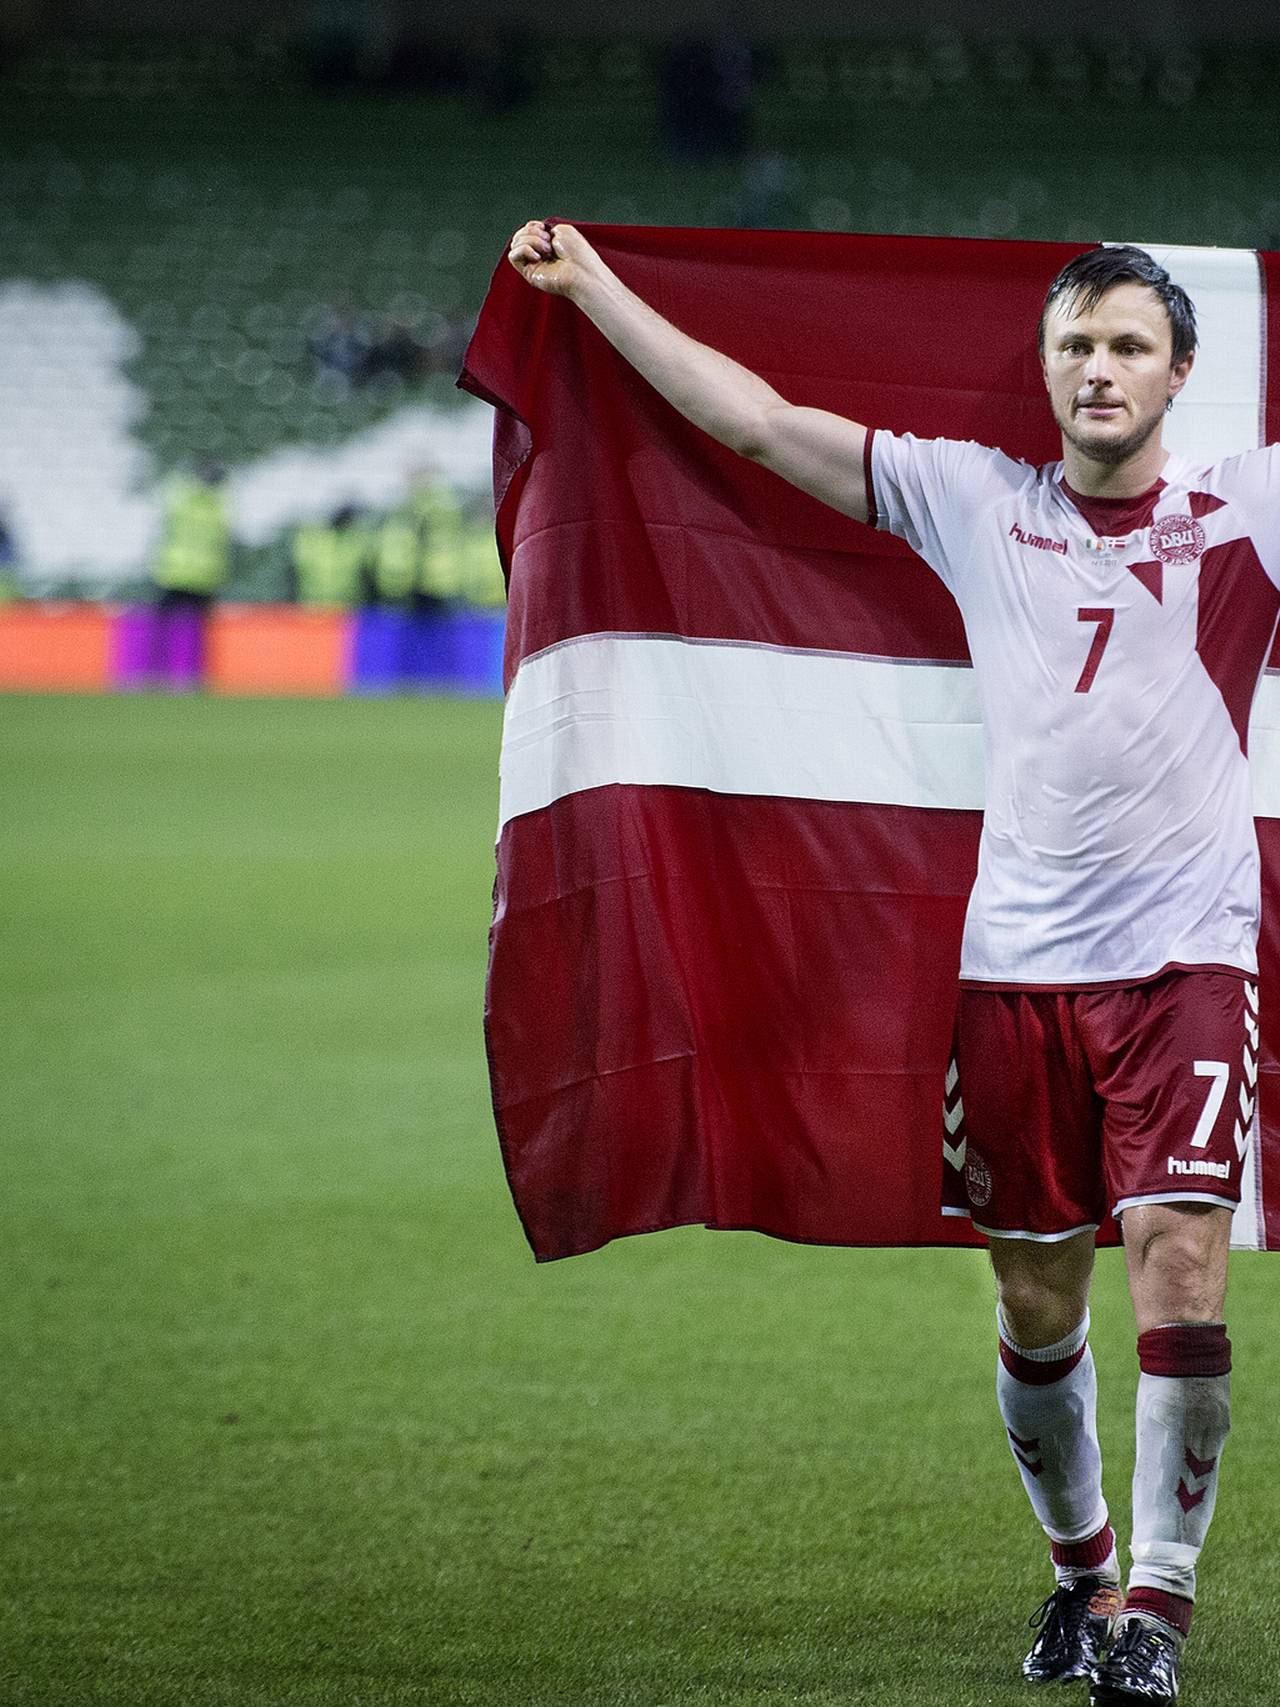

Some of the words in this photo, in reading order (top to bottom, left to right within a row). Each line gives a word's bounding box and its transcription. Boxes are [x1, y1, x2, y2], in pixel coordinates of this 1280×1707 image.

[1009, 522, 1068, 555] hummel
[1160, 530, 1196, 549] DBU
[1074, 607, 1115, 693] 7
[1190, 1060, 1229, 1148] 7
[1167, 1156, 1230, 1179] hummel
